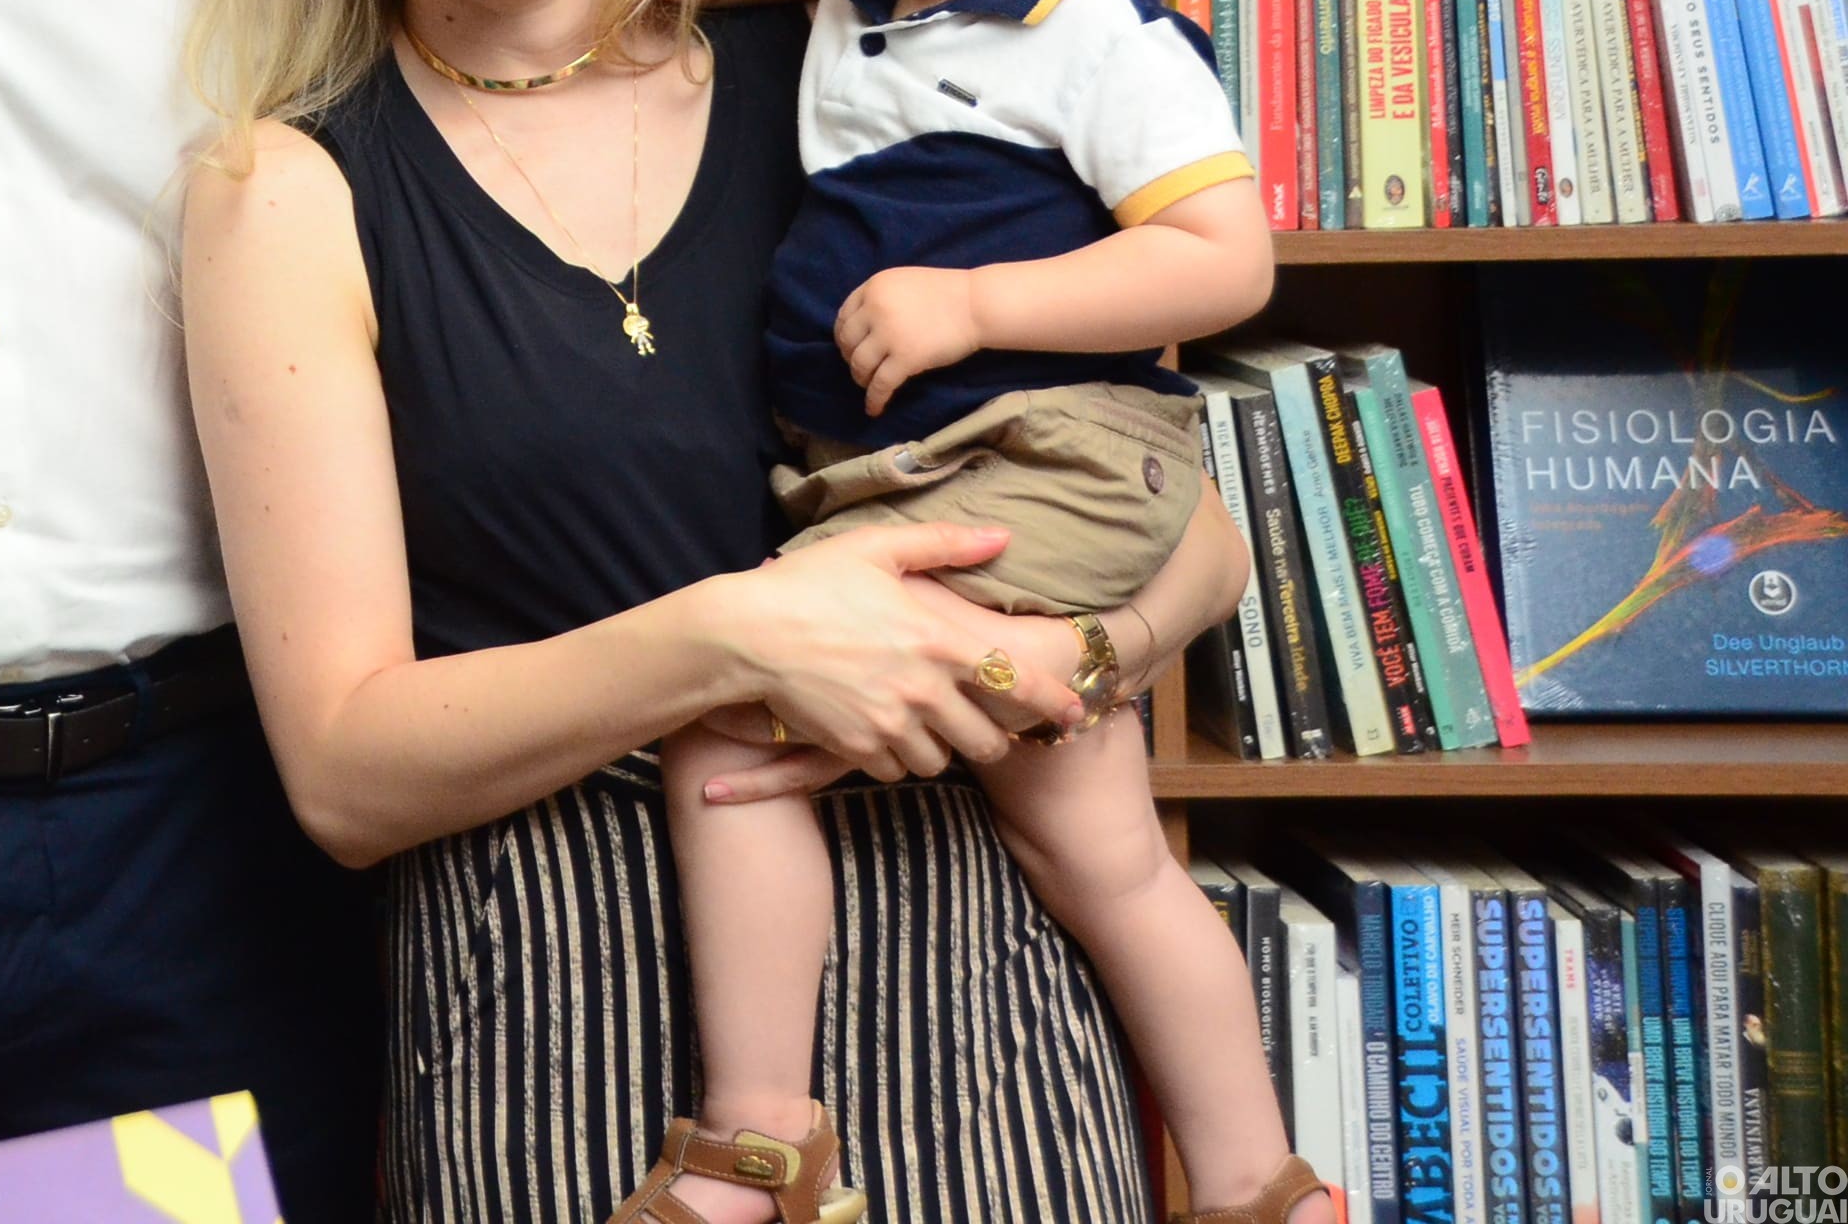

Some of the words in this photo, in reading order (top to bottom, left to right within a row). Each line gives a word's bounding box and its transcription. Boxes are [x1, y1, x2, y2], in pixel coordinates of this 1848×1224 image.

[1367, 47, 1383, 63] DO
[1689, 19, 1706, 59] SEUS
[1368, 67, 1386, 119] LIMPEZA
[1393, 82, 1414, 105] DA
[1696, 66, 1720, 145] SENTIDOS
[1395, 110, 1414, 119] E
[1317, 376, 1343, 423] CHOPRA
[1329, 423, 1352, 464] DEEPAK
[1520, 408, 1837, 444] FISIOLOGIA
[1525, 456, 1760, 491] HUMANA
[1362, 565, 1390, 607] FOME
[1239, 595, 1262, 649] SONO
[1373, 610, 1396, 645] TEM
[1713, 634, 1752, 650] Dee
[1759, 635, 1845, 654] Unglaub
[1380, 647, 1407, 688] VOCÊ
[1450, 913, 1461, 941] MEIR
[1708, 902, 1728, 947] CLIQUE
[1261, 937, 1271, 972] HOMO
[1710, 952, 1729, 982] AQUI
[1402, 919, 1422, 1032] COLETIVO
[1451, 944, 1464, 1015] SCHNEIDER
[1711, 986, 1730, 1020] PARA
[1366, 1041, 1382, 1051] O
[1475, 898, 1517, 1197] SUPERSENTIDOS
[1517, 899, 1561, 1198] SUPERSENTIDOS
[1671, 1017, 1691, 1045] UMA
[1713, 1025, 1732, 1069] MATAR
[1455, 1038, 1470, 1082] SAÚDE
[1672, 1047, 1694, 1081] BREVE
[1367, 1054, 1388, 1119] CAMINHO
[1716, 1074, 1734, 1107] TODO
[1457, 1088, 1470, 1135] VISUAL
[1675, 1084, 1698, 1137] HISTÓRIA
[1371, 1122, 1390, 1141] DO
[1681, 1141, 1698, 1157] DO
[1718, 1112, 1738, 1159] MUNDO
[1372, 1144, 1394, 1199] CENTRO
[1461, 1140, 1472, 1168] POR
[1463, 1173, 1474, 1209] TODA
[1681, 1160, 1700, 1198] TEMPO
